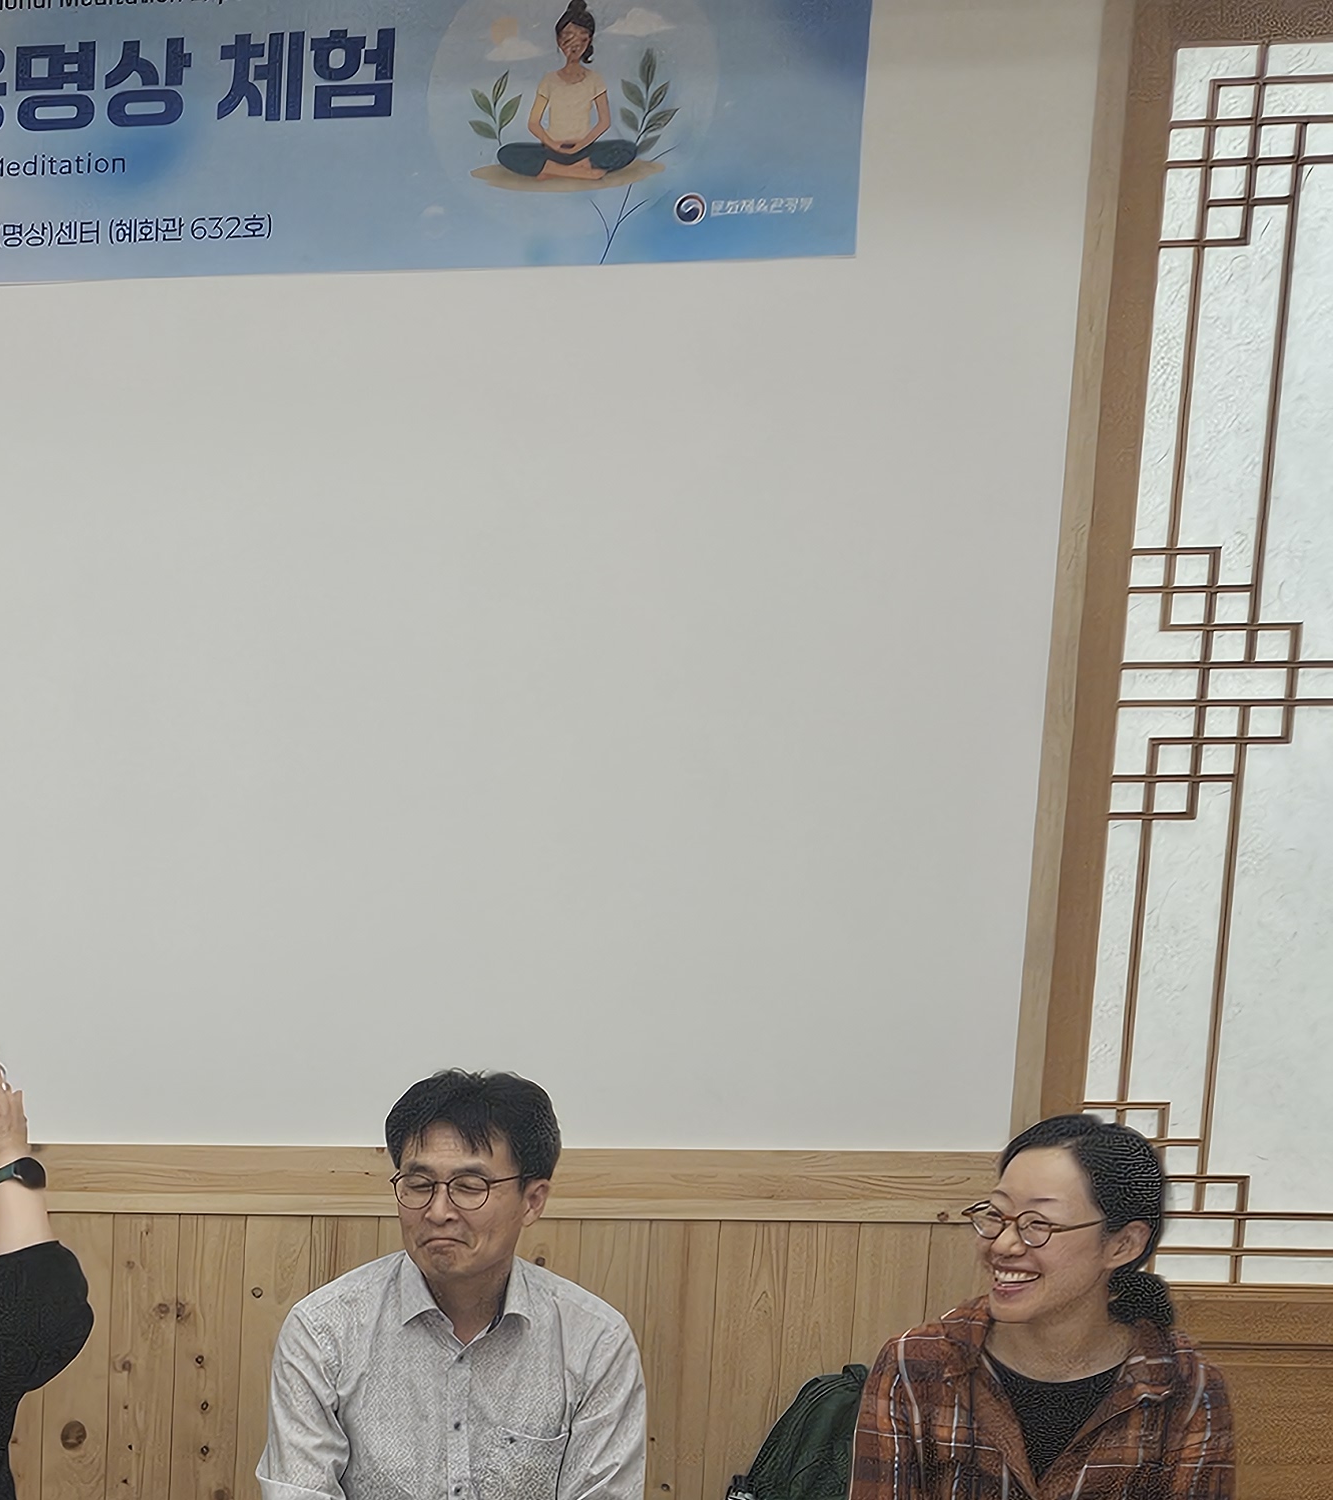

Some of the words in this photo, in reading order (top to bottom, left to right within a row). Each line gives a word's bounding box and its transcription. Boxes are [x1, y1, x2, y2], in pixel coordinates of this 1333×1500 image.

[216, 28, 396, 122] 체험
[108, 217, 185, 245] (혜화관
[190, 213, 273, 241] 632호)
